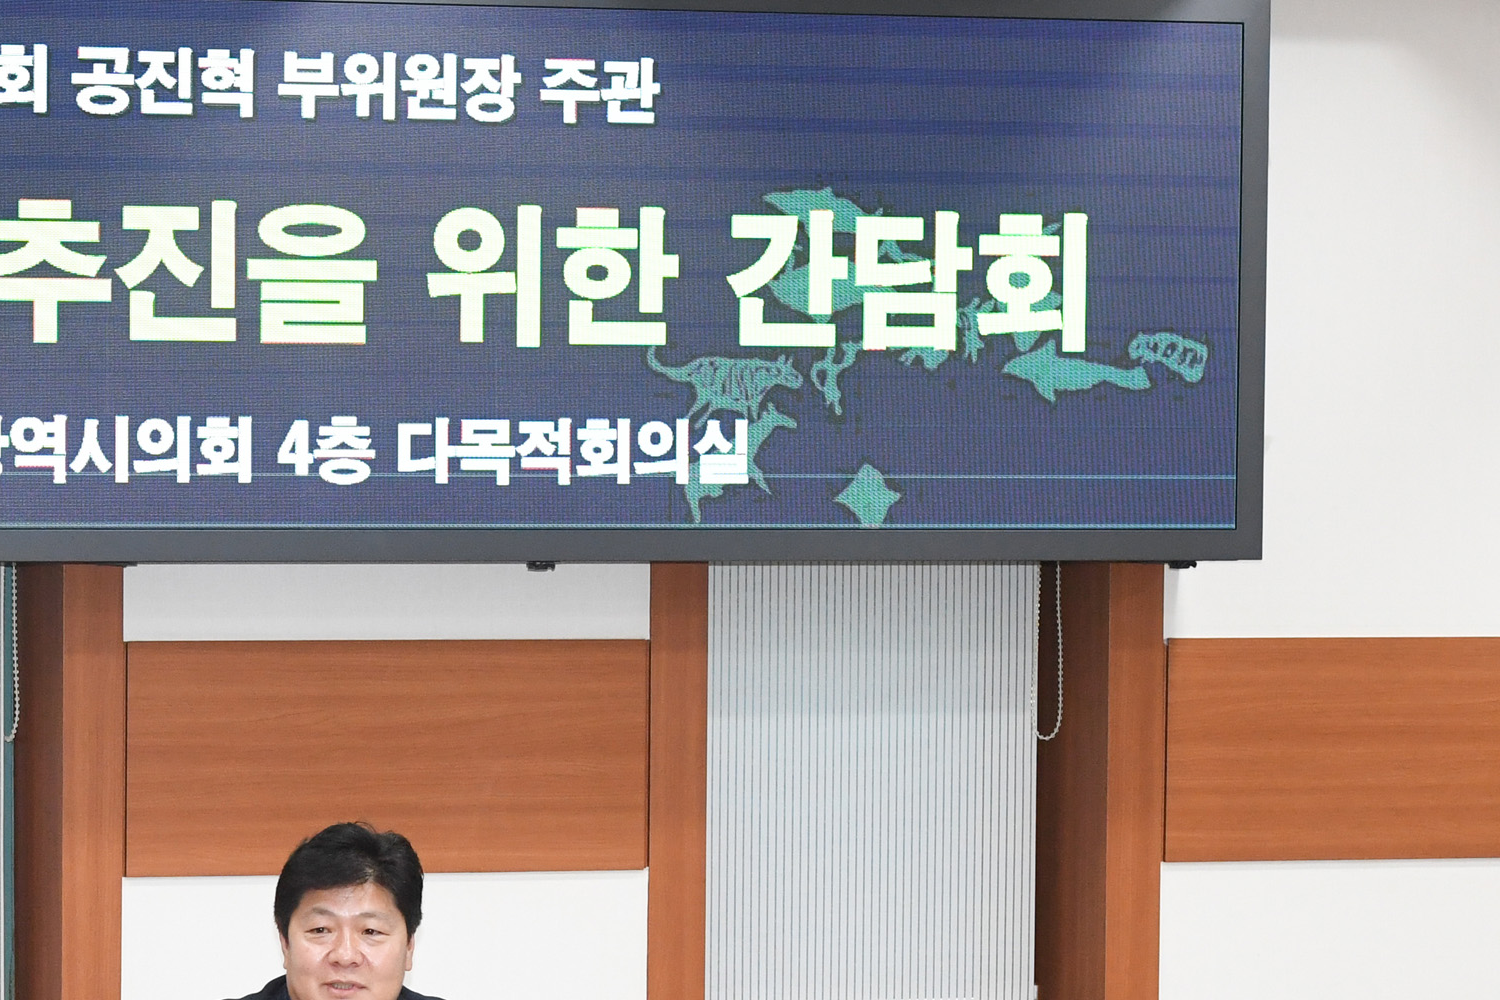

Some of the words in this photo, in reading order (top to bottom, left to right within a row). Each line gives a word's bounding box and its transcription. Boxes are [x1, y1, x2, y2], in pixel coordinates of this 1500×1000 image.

[71, 46, 256, 119] 공진혁
[277, 51, 523, 124] 부위원장
[540, 57, 662, 126] 주관
[426, 205, 680, 349] 위한
[726, 210, 1090, 353] 간담회
[277, 416, 378, 487] 4층
[397, 417, 751, 487] 다목적회의실
